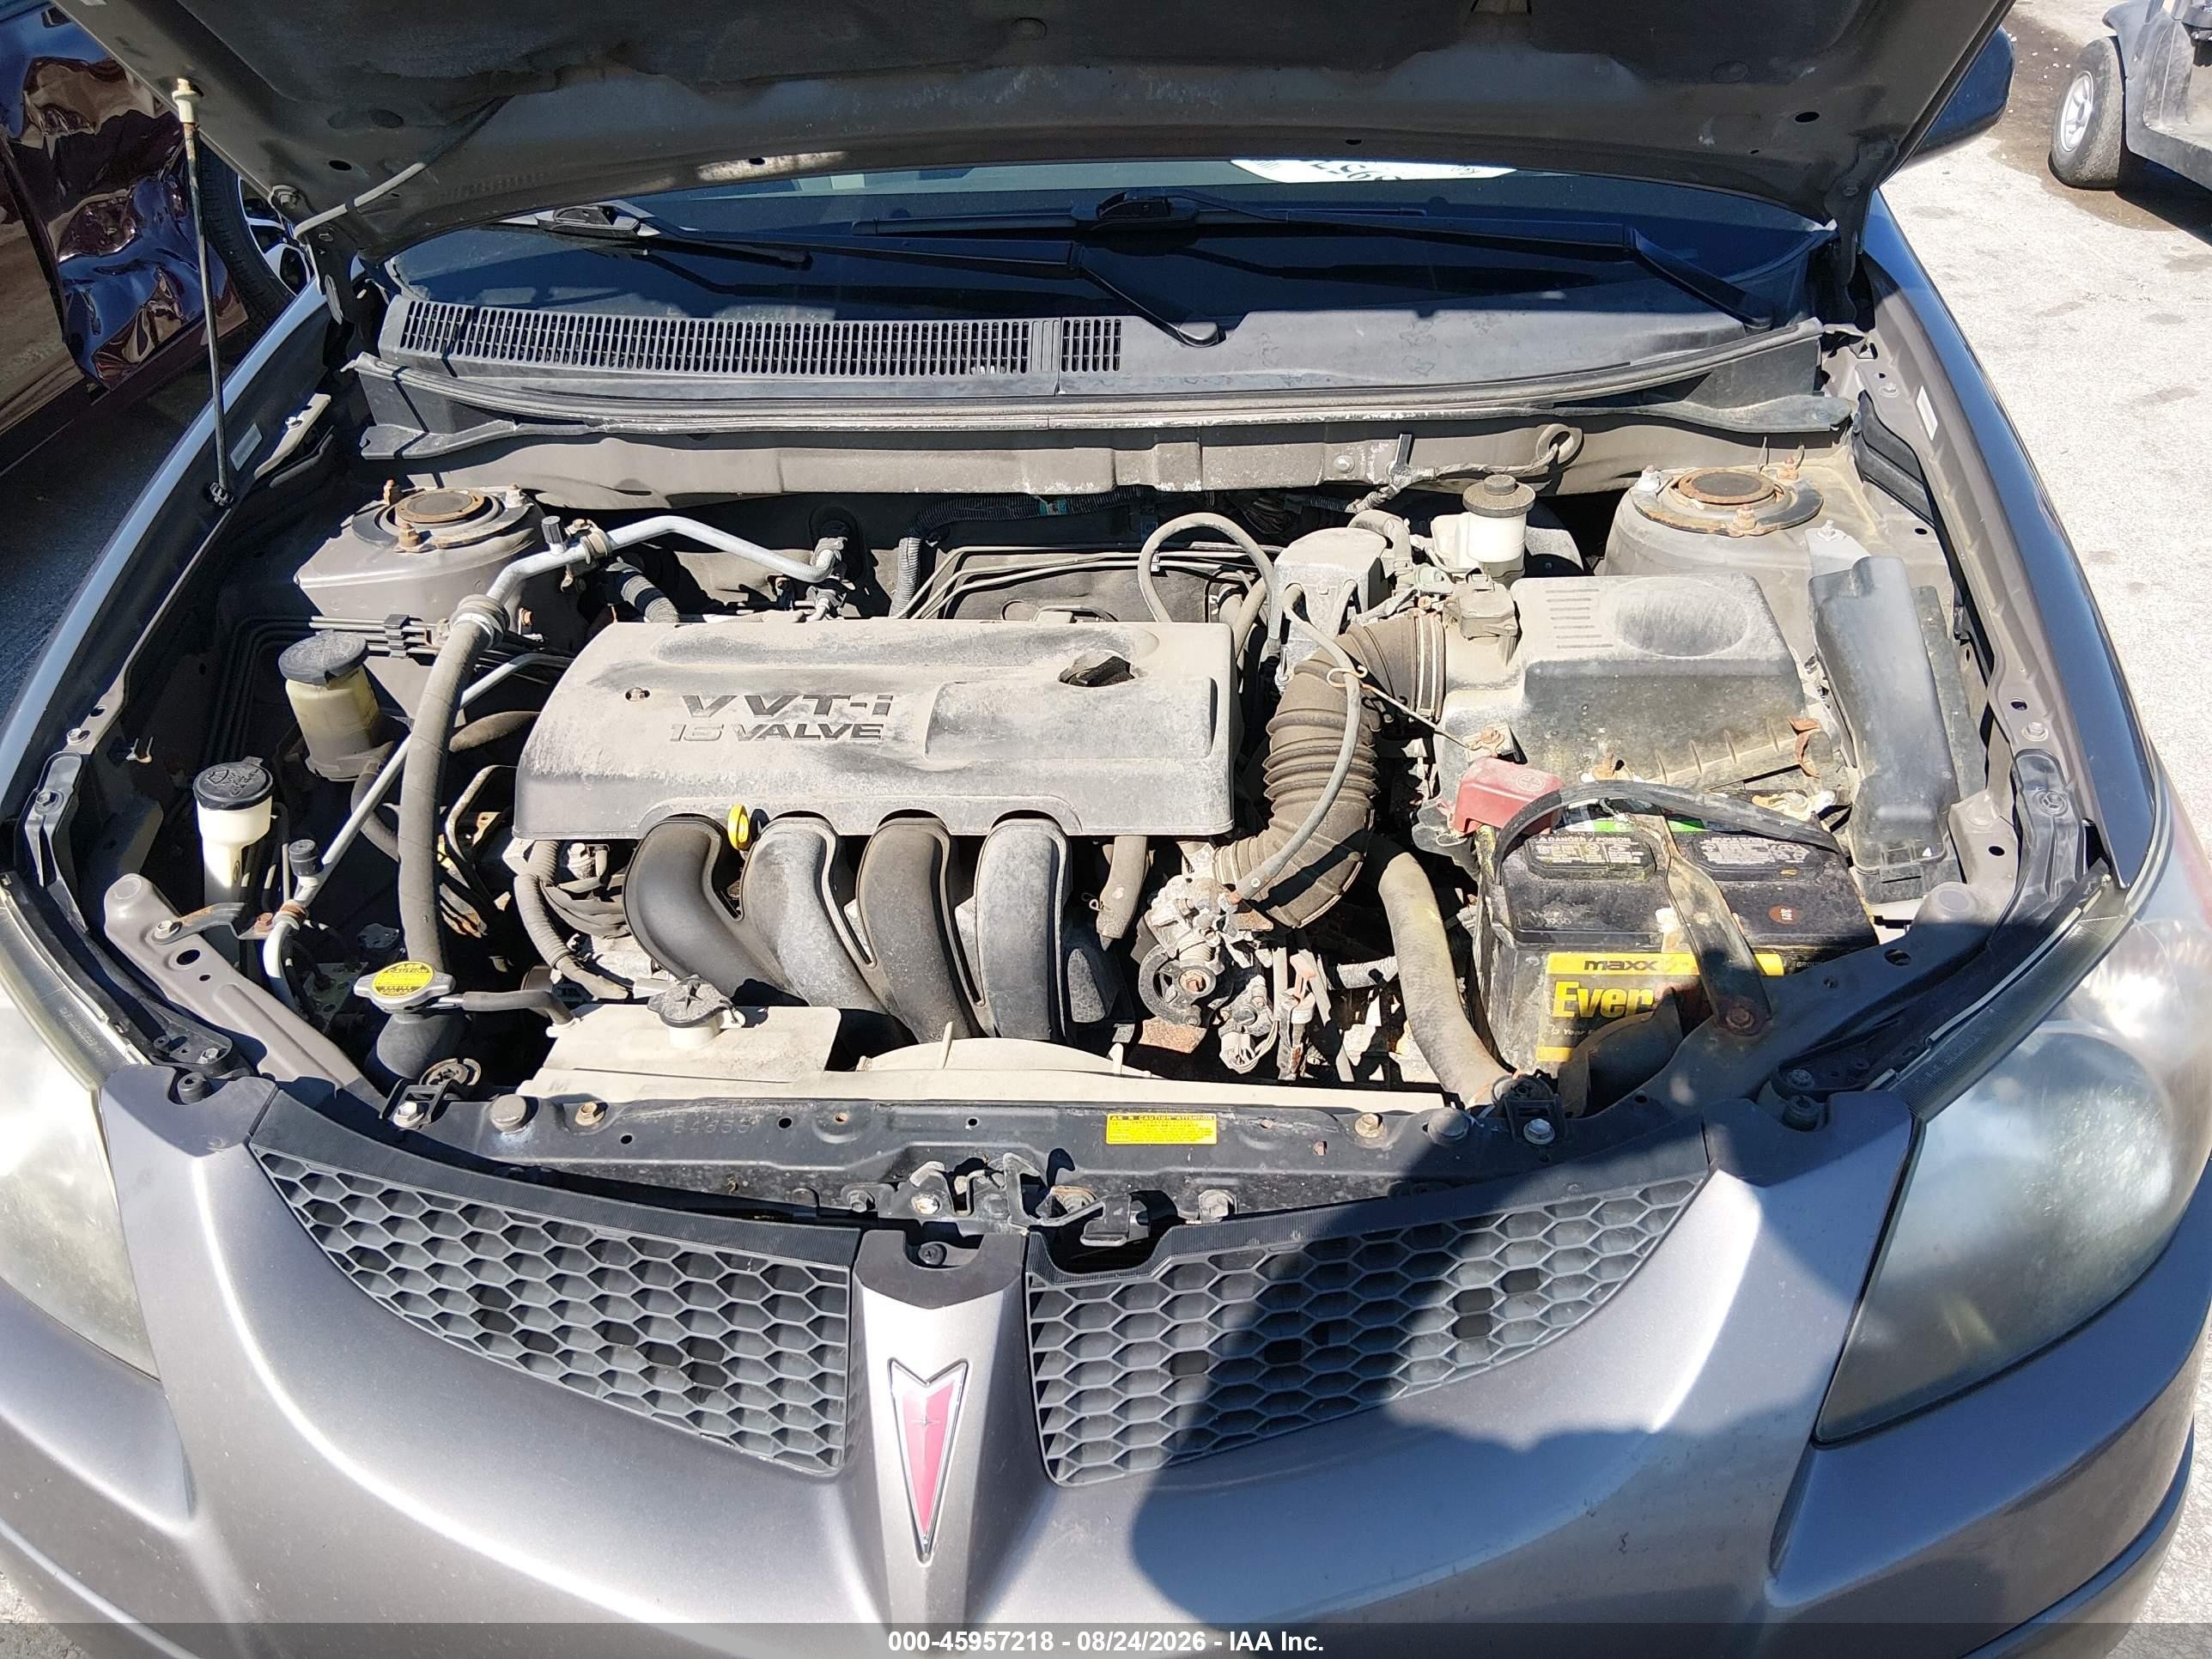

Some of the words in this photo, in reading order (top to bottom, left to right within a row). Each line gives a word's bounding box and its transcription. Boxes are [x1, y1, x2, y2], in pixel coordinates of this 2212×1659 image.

[680, 693, 894, 718] VVT-i
[669, 723, 724, 743] 16
[731, 723, 885, 743] VALVE
[1583, 959, 1660, 971] maxx
